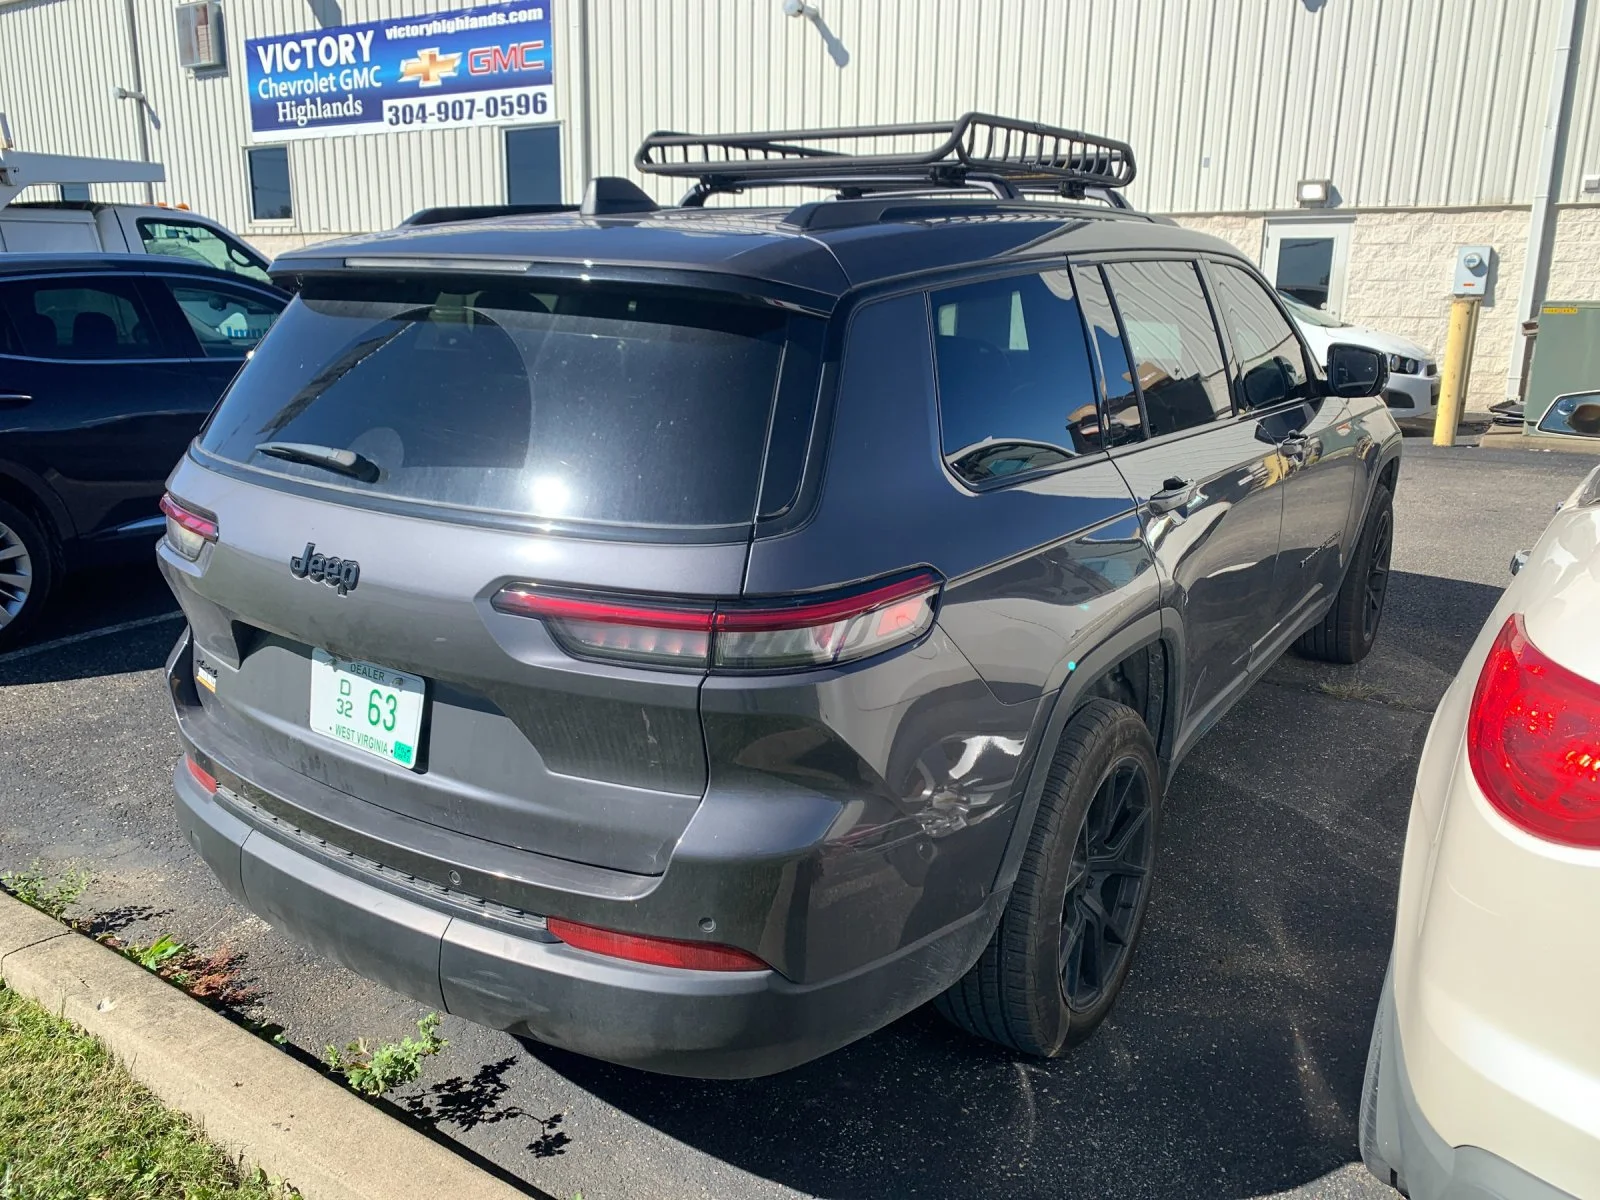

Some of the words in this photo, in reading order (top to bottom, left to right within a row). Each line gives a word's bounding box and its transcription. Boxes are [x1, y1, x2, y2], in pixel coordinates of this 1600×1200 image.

[385, 8, 542, 40] victoryhighlands.com
[257, 30, 374, 74] VICTORY
[468, 40, 545, 75] GMC
[257, 73, 336, 99] Chevrolet
[340, 66, 382, 90] GMC
[276, 94, 363, 126] Highlands
[387, 92, 548, 126] 304-907-0596
[290, 542, 361, 598] Jeep
[339, 679, 351, 696] D
[350, 663, 385, 681] DEALER
[336, 699, 353, 718] 32
[367, 689, 398, 732] 63
[335, 723, 356, 742] WEST
[356, 731, 388, 755] VIRGINIA
